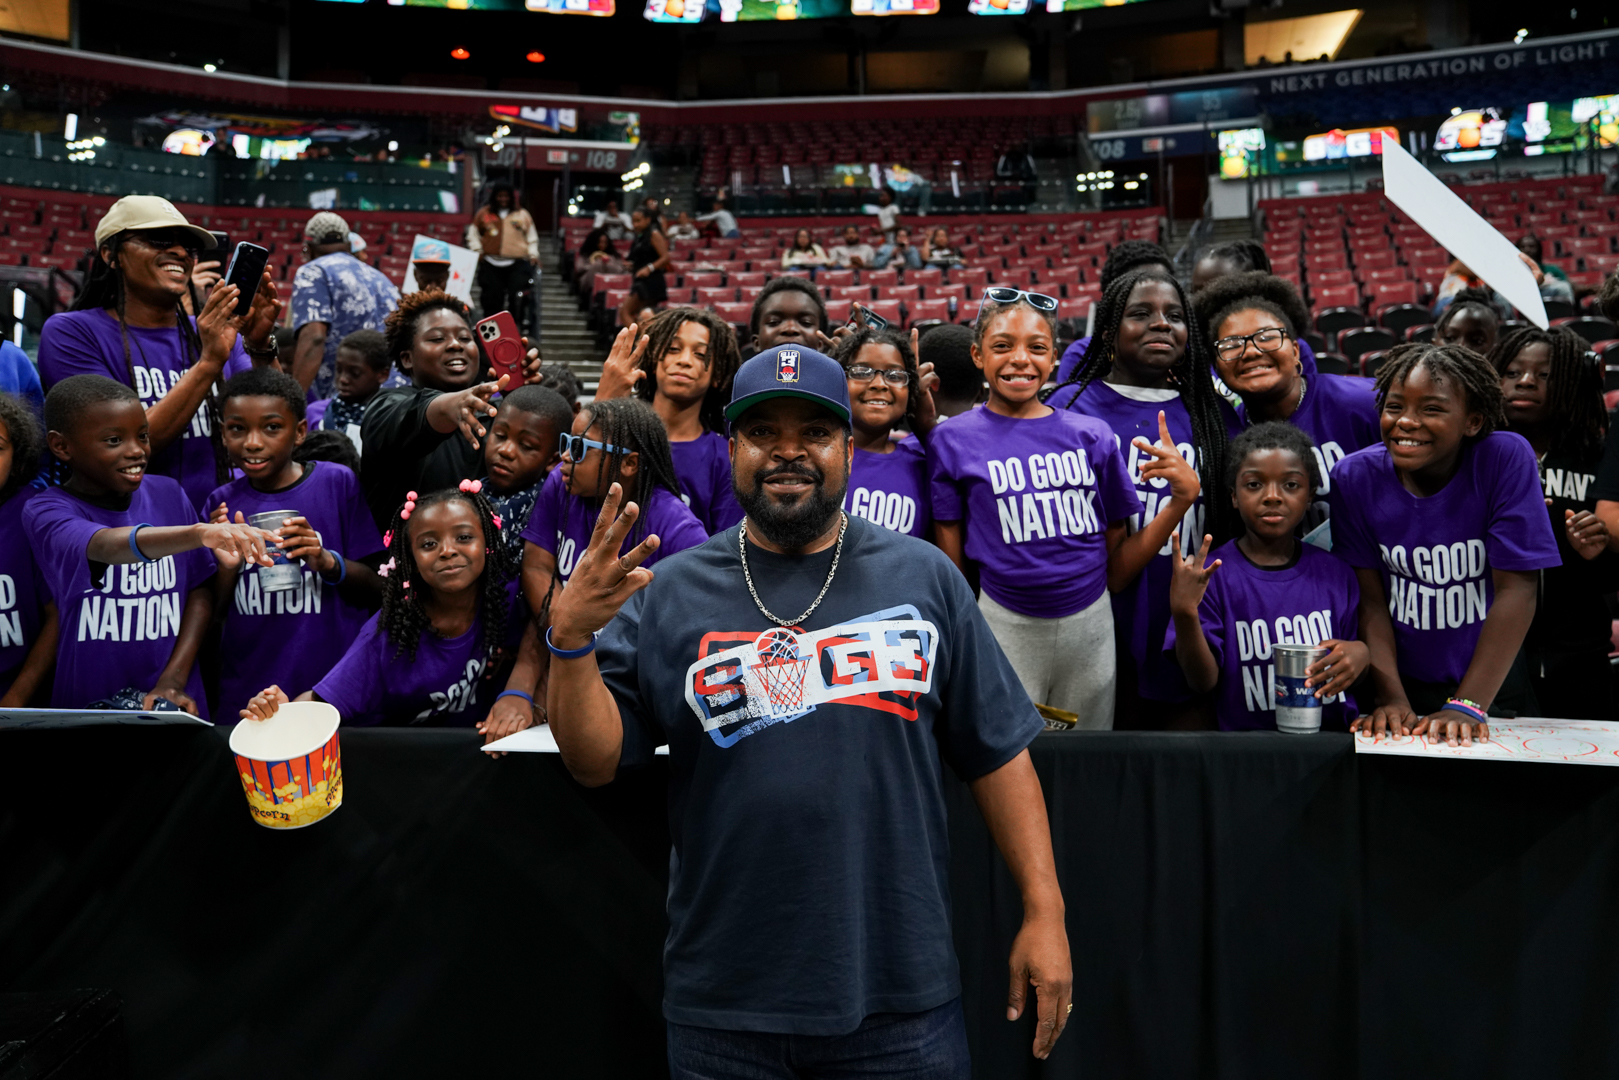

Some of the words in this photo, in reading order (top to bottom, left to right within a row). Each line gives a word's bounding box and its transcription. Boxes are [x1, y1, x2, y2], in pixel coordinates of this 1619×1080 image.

[1270, 74, 1328, 93] NEXT
[1336, 56, 1485, 87] GENERATION
[1494, 51, 1527, 70] OF
[1536, 40, 1611, 66] LIGHT
[586, 150, 617, 169] 108
[133, 365, 168, 399] DO
[987, 457, 1026, 495] DO
[1028, 449, 1096, 490] GOOD
[851, 487, 916, 534] GOOD
[996, 489, 1099, 544] NATION
[120, 555, 177, 595] GOOD
[1379, 543, 1413, 578] DO
[1412, 539, 1486, 585] GOOD
[77, 592, 181, 642] NATION
[1389, 574, 1487, 631] NATION
[1235, 619, 1272, 661] DO
